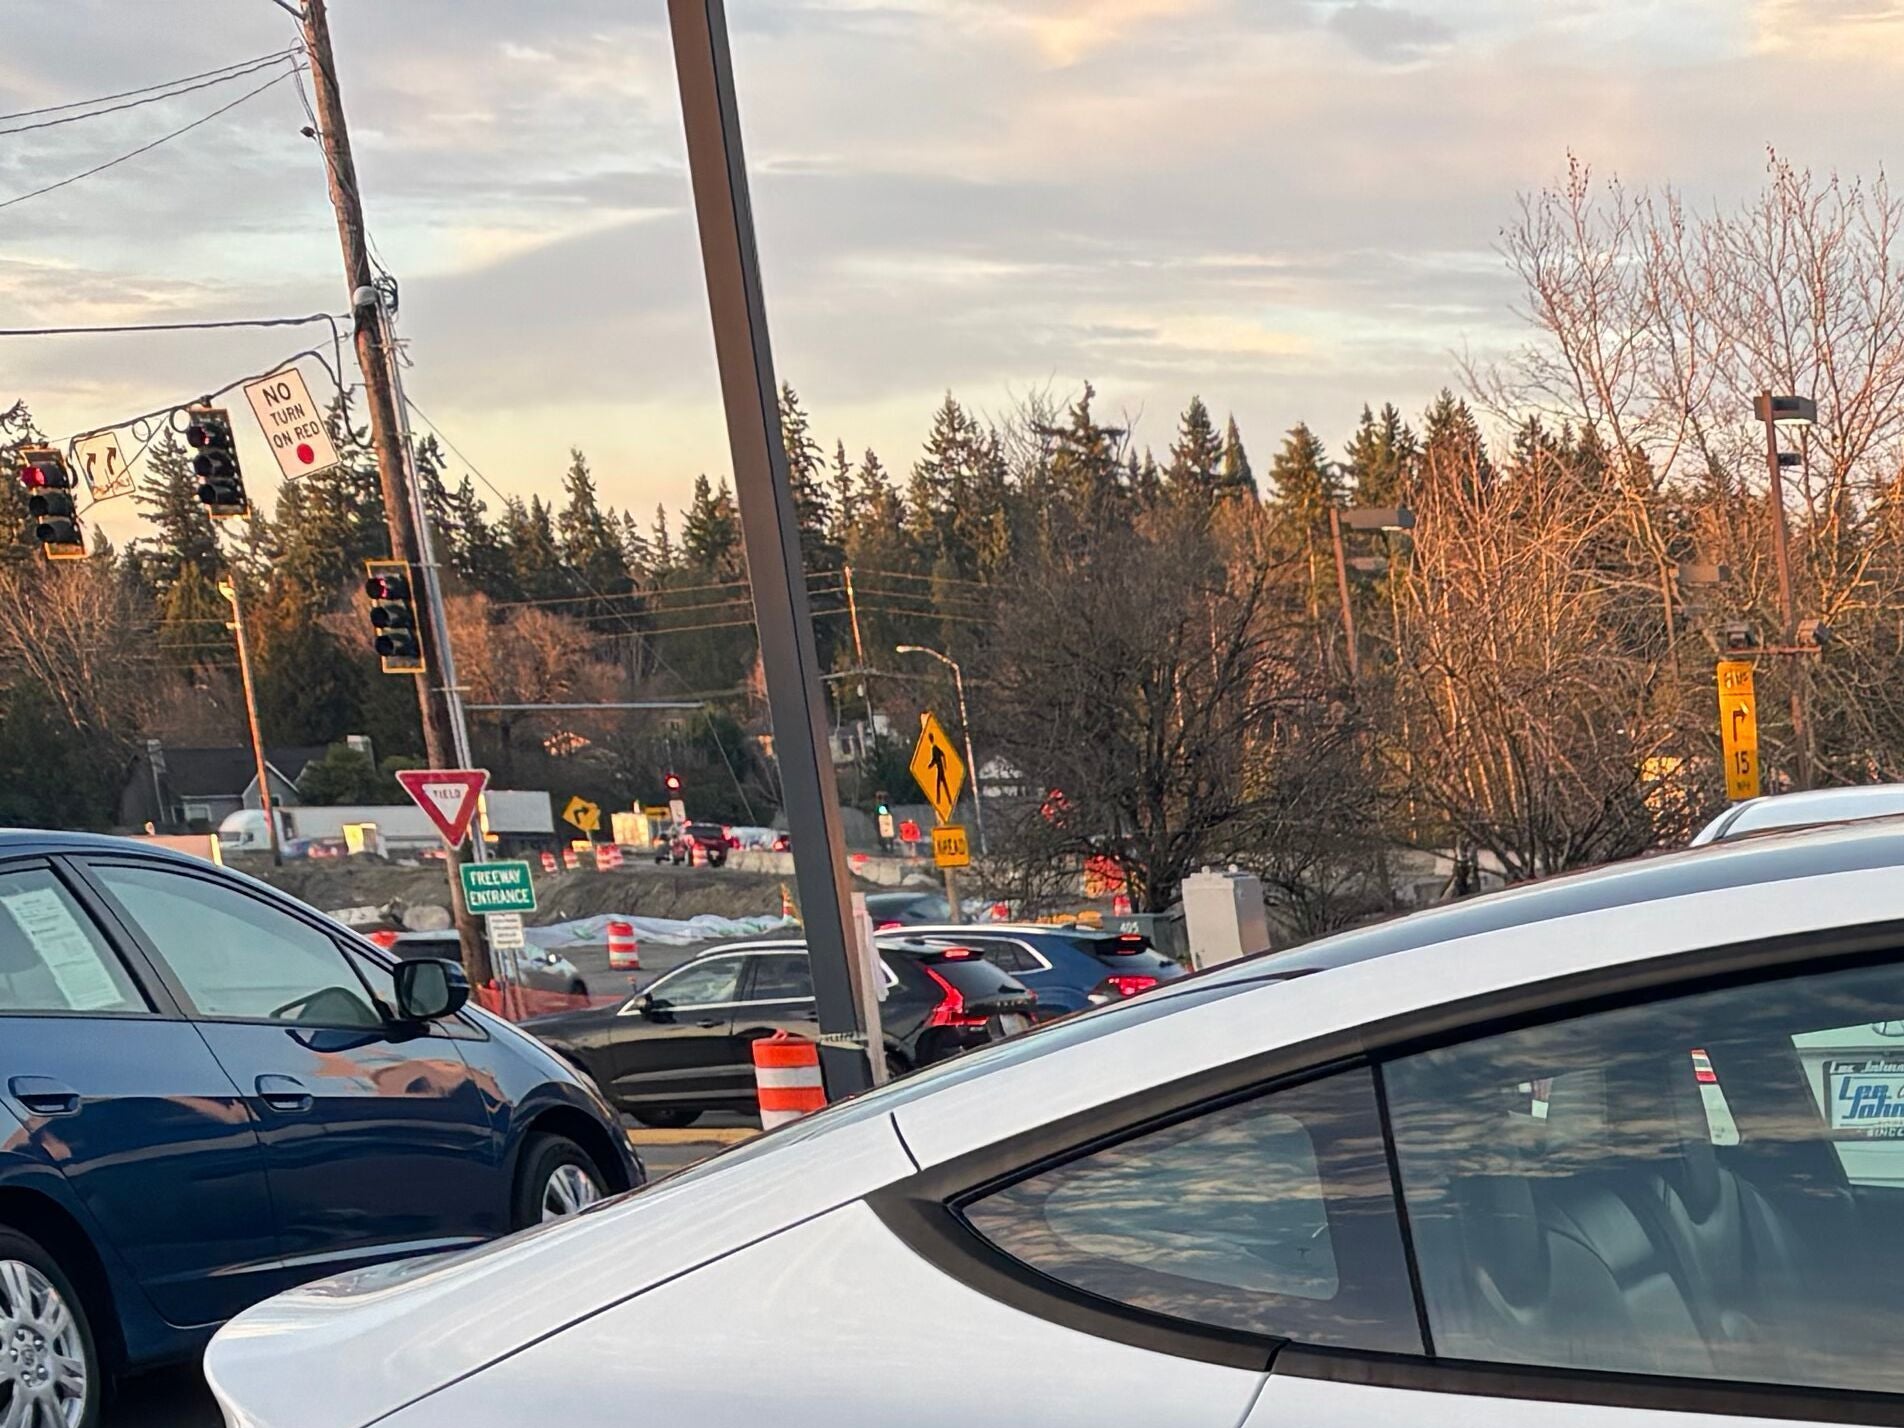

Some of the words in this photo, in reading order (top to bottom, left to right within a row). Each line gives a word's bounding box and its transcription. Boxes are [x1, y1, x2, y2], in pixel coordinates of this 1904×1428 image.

[262, 382, 291, 407] NO
[270, 403, 306, 426] TURN
[273, 430, 294, 448] ON
[294, 421, 320, 439] RED
[1735, 751, 1750, 775] 15
[433, 789, 461, 800] YIELD
[470, 869, 521, 886] FREEWAY
[469, 888, 530, 906] ENTRANCE
[1839, 1076, 1892, 1100] Lee
